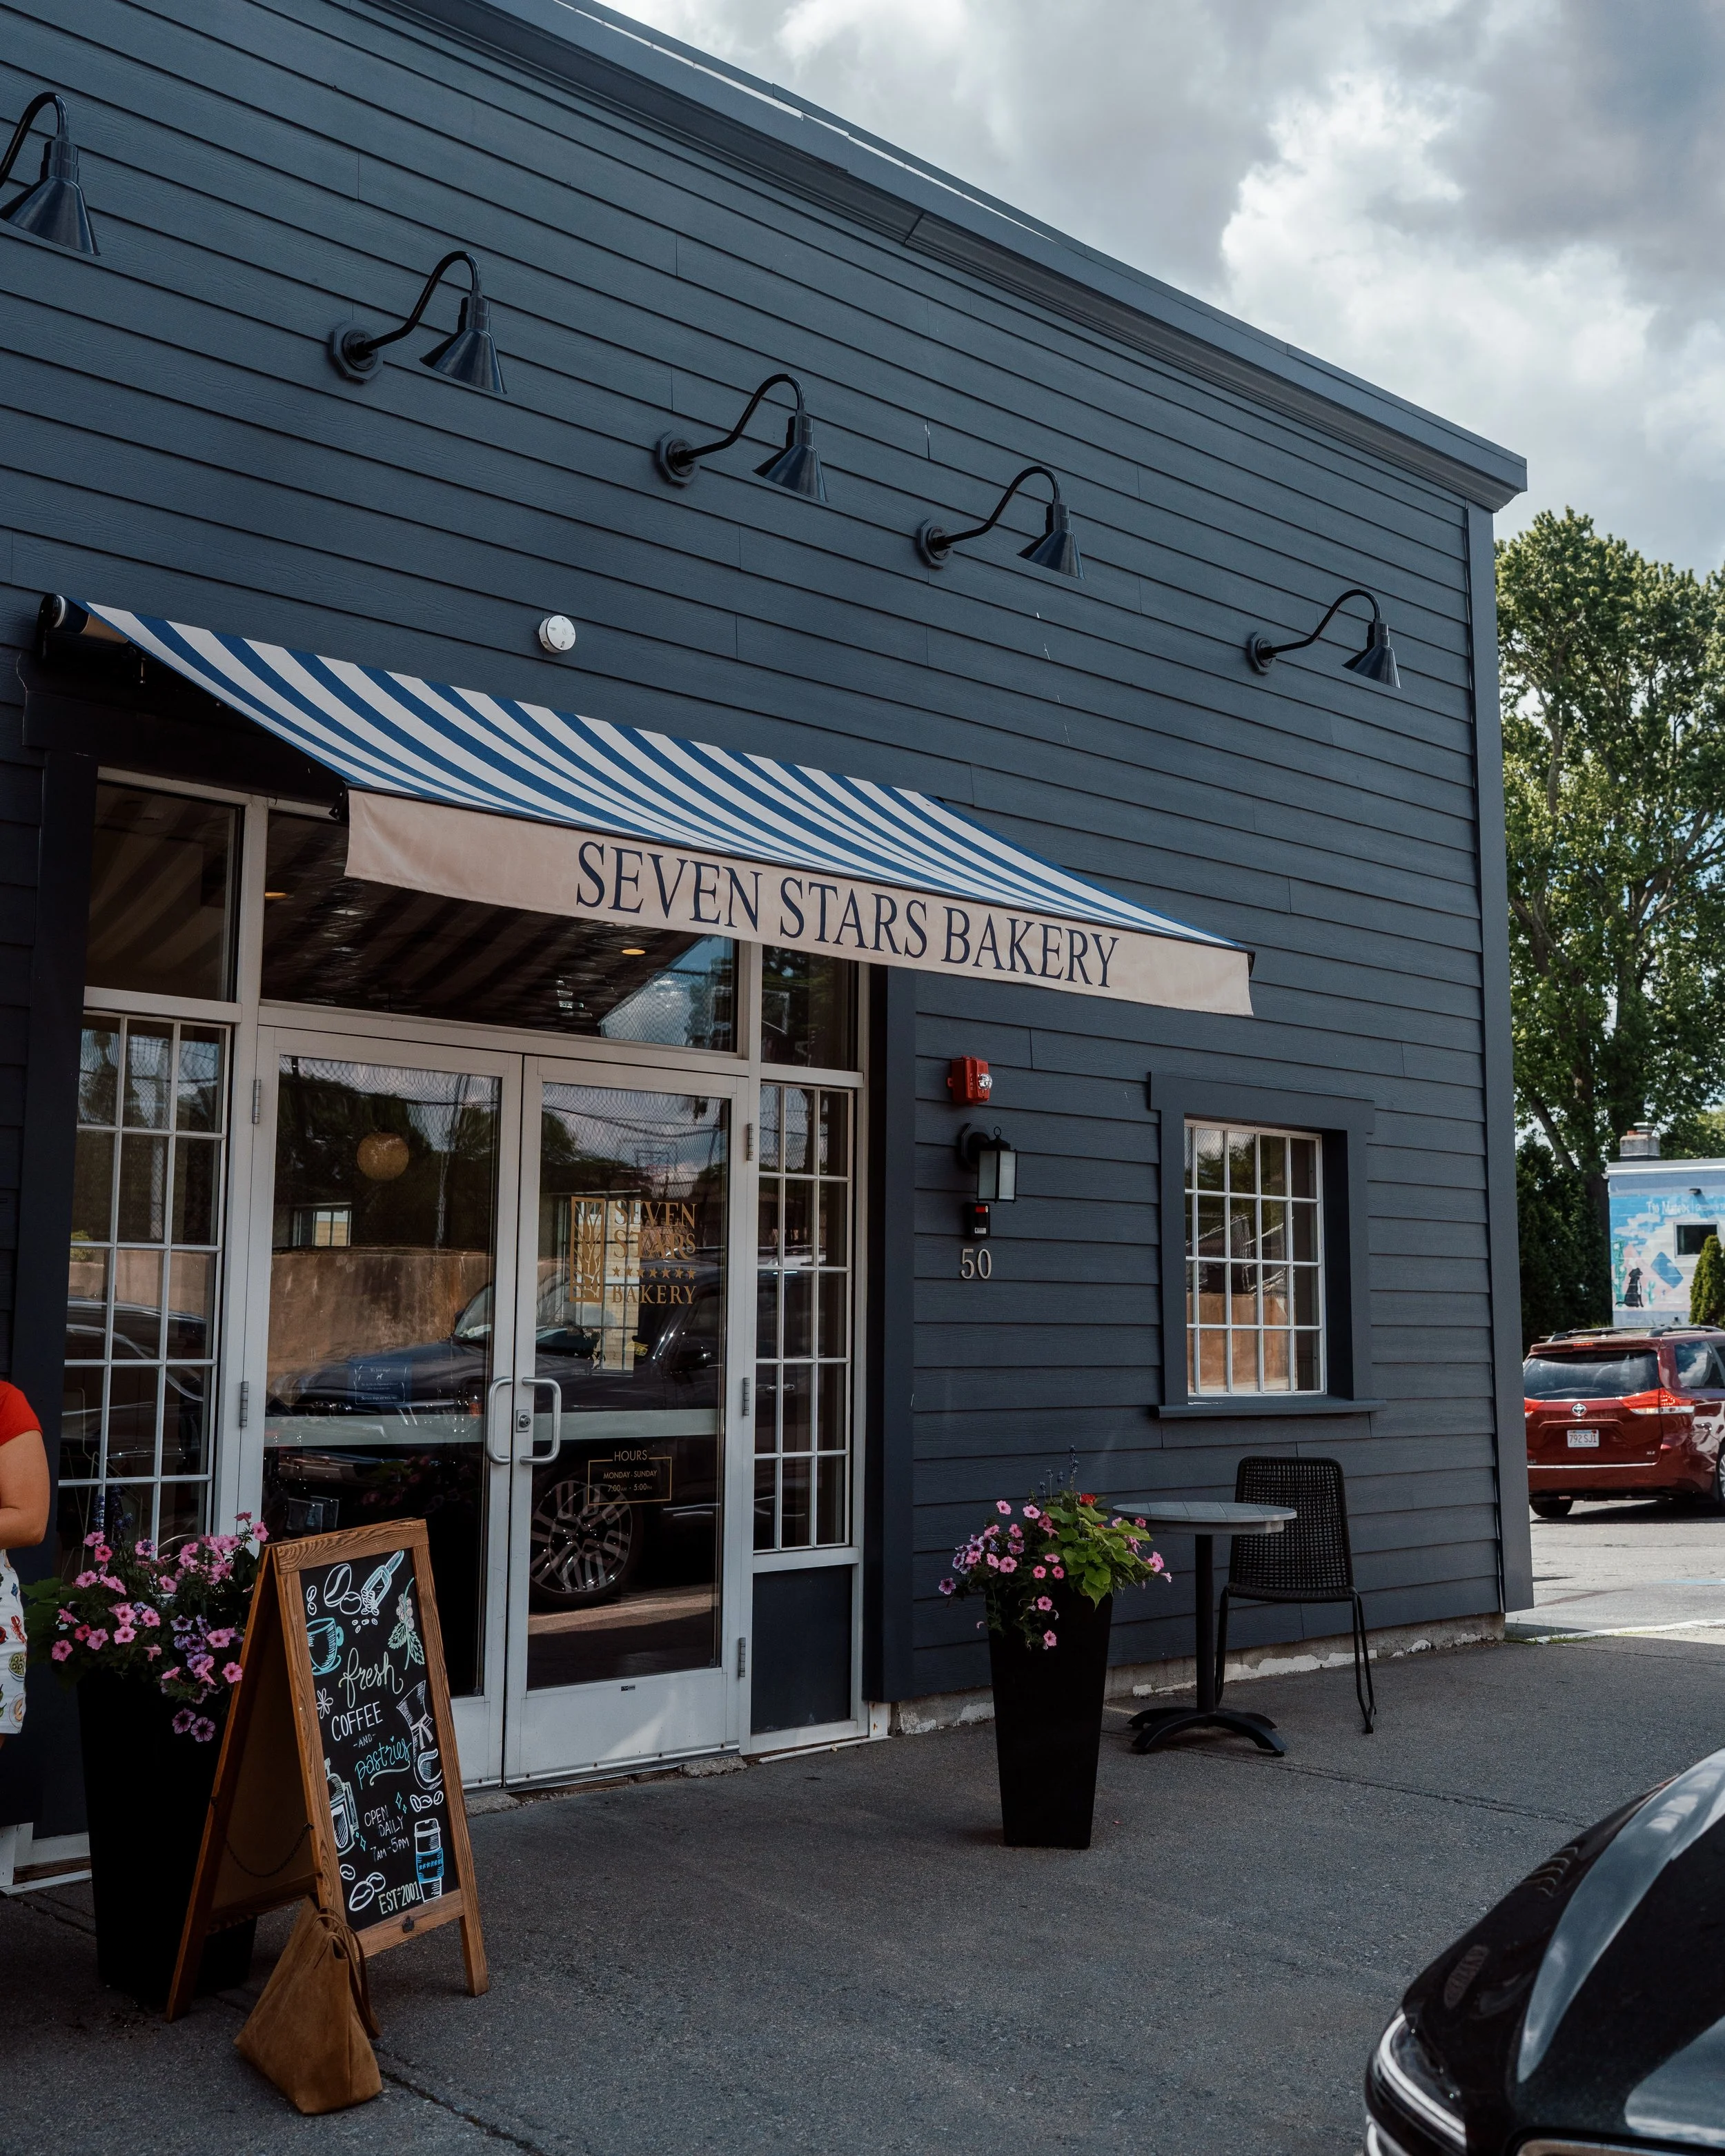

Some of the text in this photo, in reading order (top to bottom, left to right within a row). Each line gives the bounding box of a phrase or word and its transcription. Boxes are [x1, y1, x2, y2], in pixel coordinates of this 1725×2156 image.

[576, 841, 1120, 988] SEVEN STARS BAKERY
[614, 1198, 698, 1229] SEVEN
[613, 1229, 696, 1260] STARS
[960, 1248, 992, 1279] 50
[611, 1284, 697, 1304] BAKERY
[1569, 1434, 1597, 1443] 792 SJ1
[614, 1450, 647, 1461] HOURS
[603, 1470, 658, 1480] MONDAY SUNDAY
[338, 1647, 404, 1709] fresh
[331, 1701, 384, 1741] COFFEE
[355, 1736, 413, 1790] pastries
[364, 1804, 389, 1827] OPEN
[378, 1815, 404, 1837] DAILY
